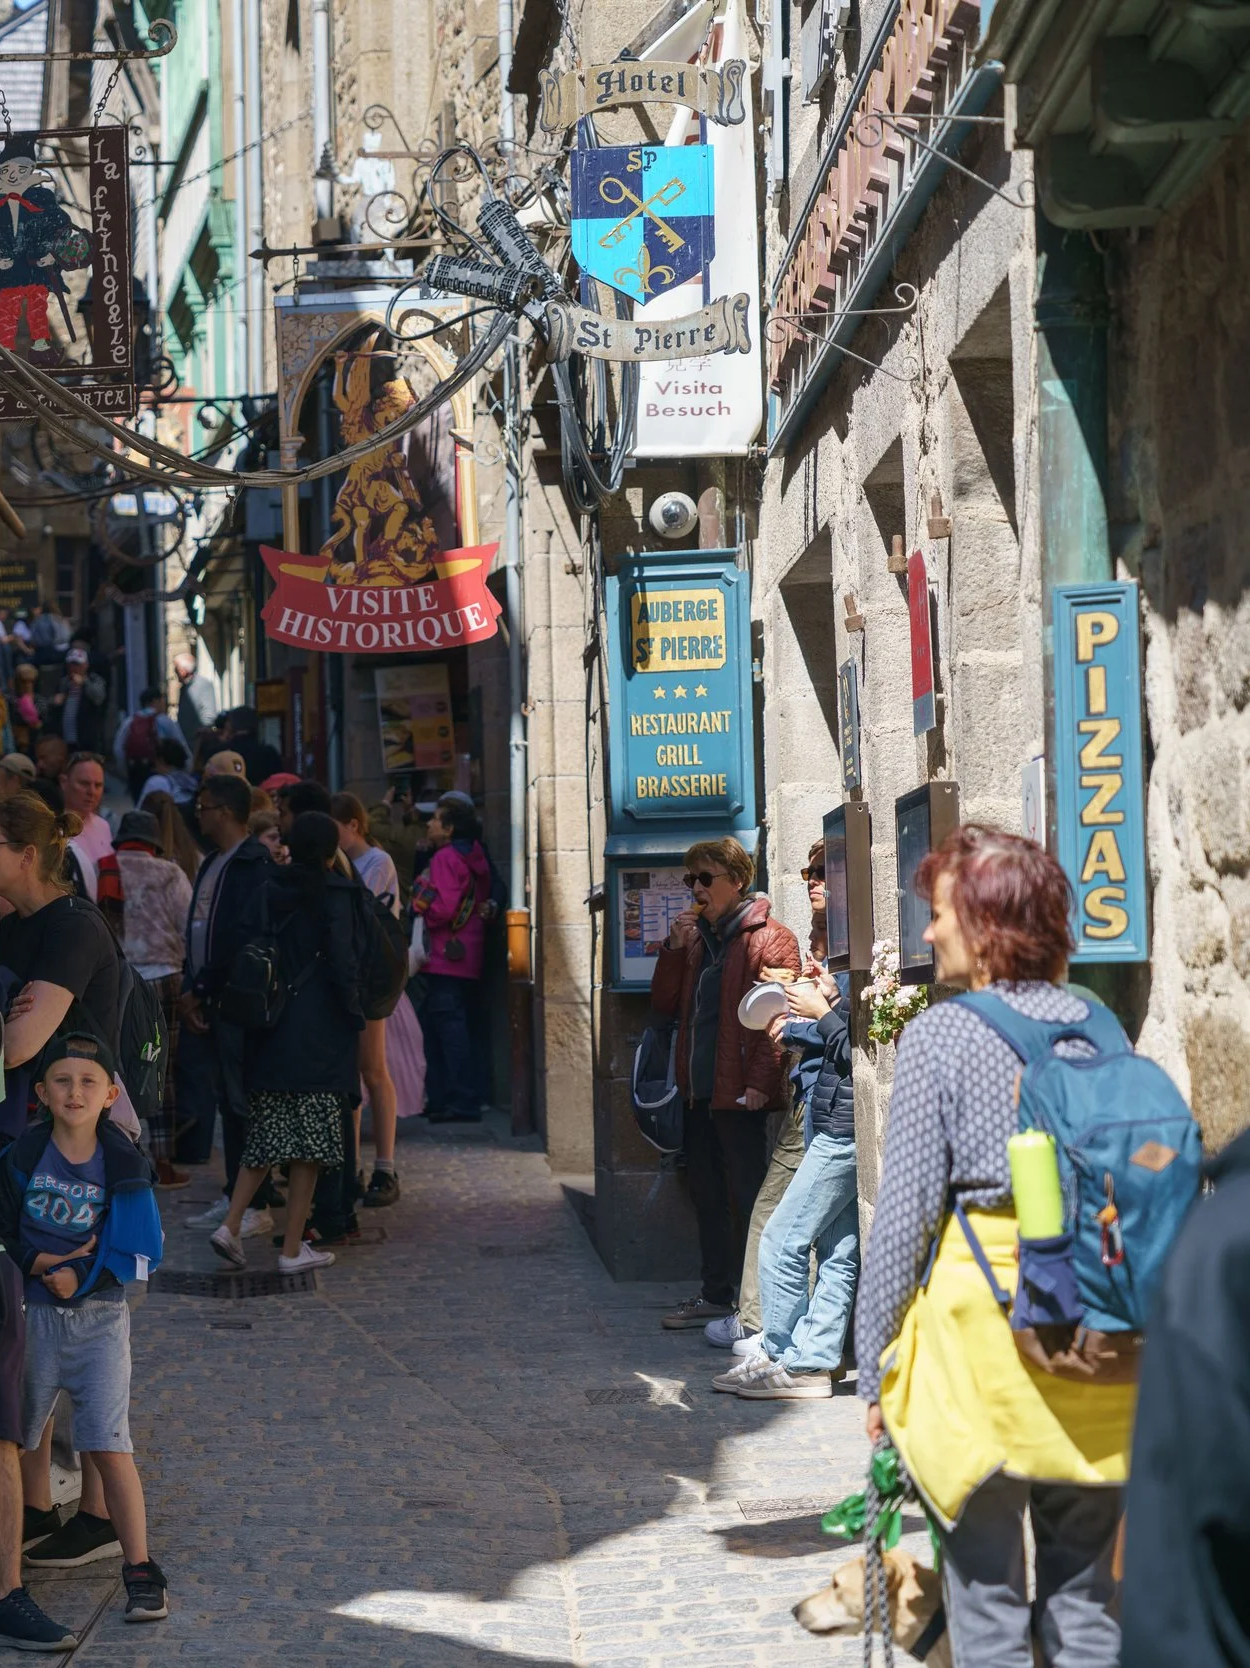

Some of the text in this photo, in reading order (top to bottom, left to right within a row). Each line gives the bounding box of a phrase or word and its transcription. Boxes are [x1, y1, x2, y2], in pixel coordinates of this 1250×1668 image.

[596, 69, 686, 104] Hotel
[93, 138, 121, 181] La
[576, 320, 716, 354] St Pierre
[655, 380, 723, 395] Visita
[646, 402, 732, 417] Besuch
[326, 585, 439, 616] VISITE
[637, 599, 718, 624] AUBERGE
[275, 602, 488, 649] HISTORIQUE
[661, 635, 723, 661] PIERRE
[630, 711, 732, 736] RESTAURANT
[656, 744, 703, 766] GRILL
[636, 774, 727, 798] BRASSERIE
[1075, 611, 1129, 941] PIZZAS
[33, 1175, 99, 1199] ERROR
[26, 1193, 97, 1228] 404
